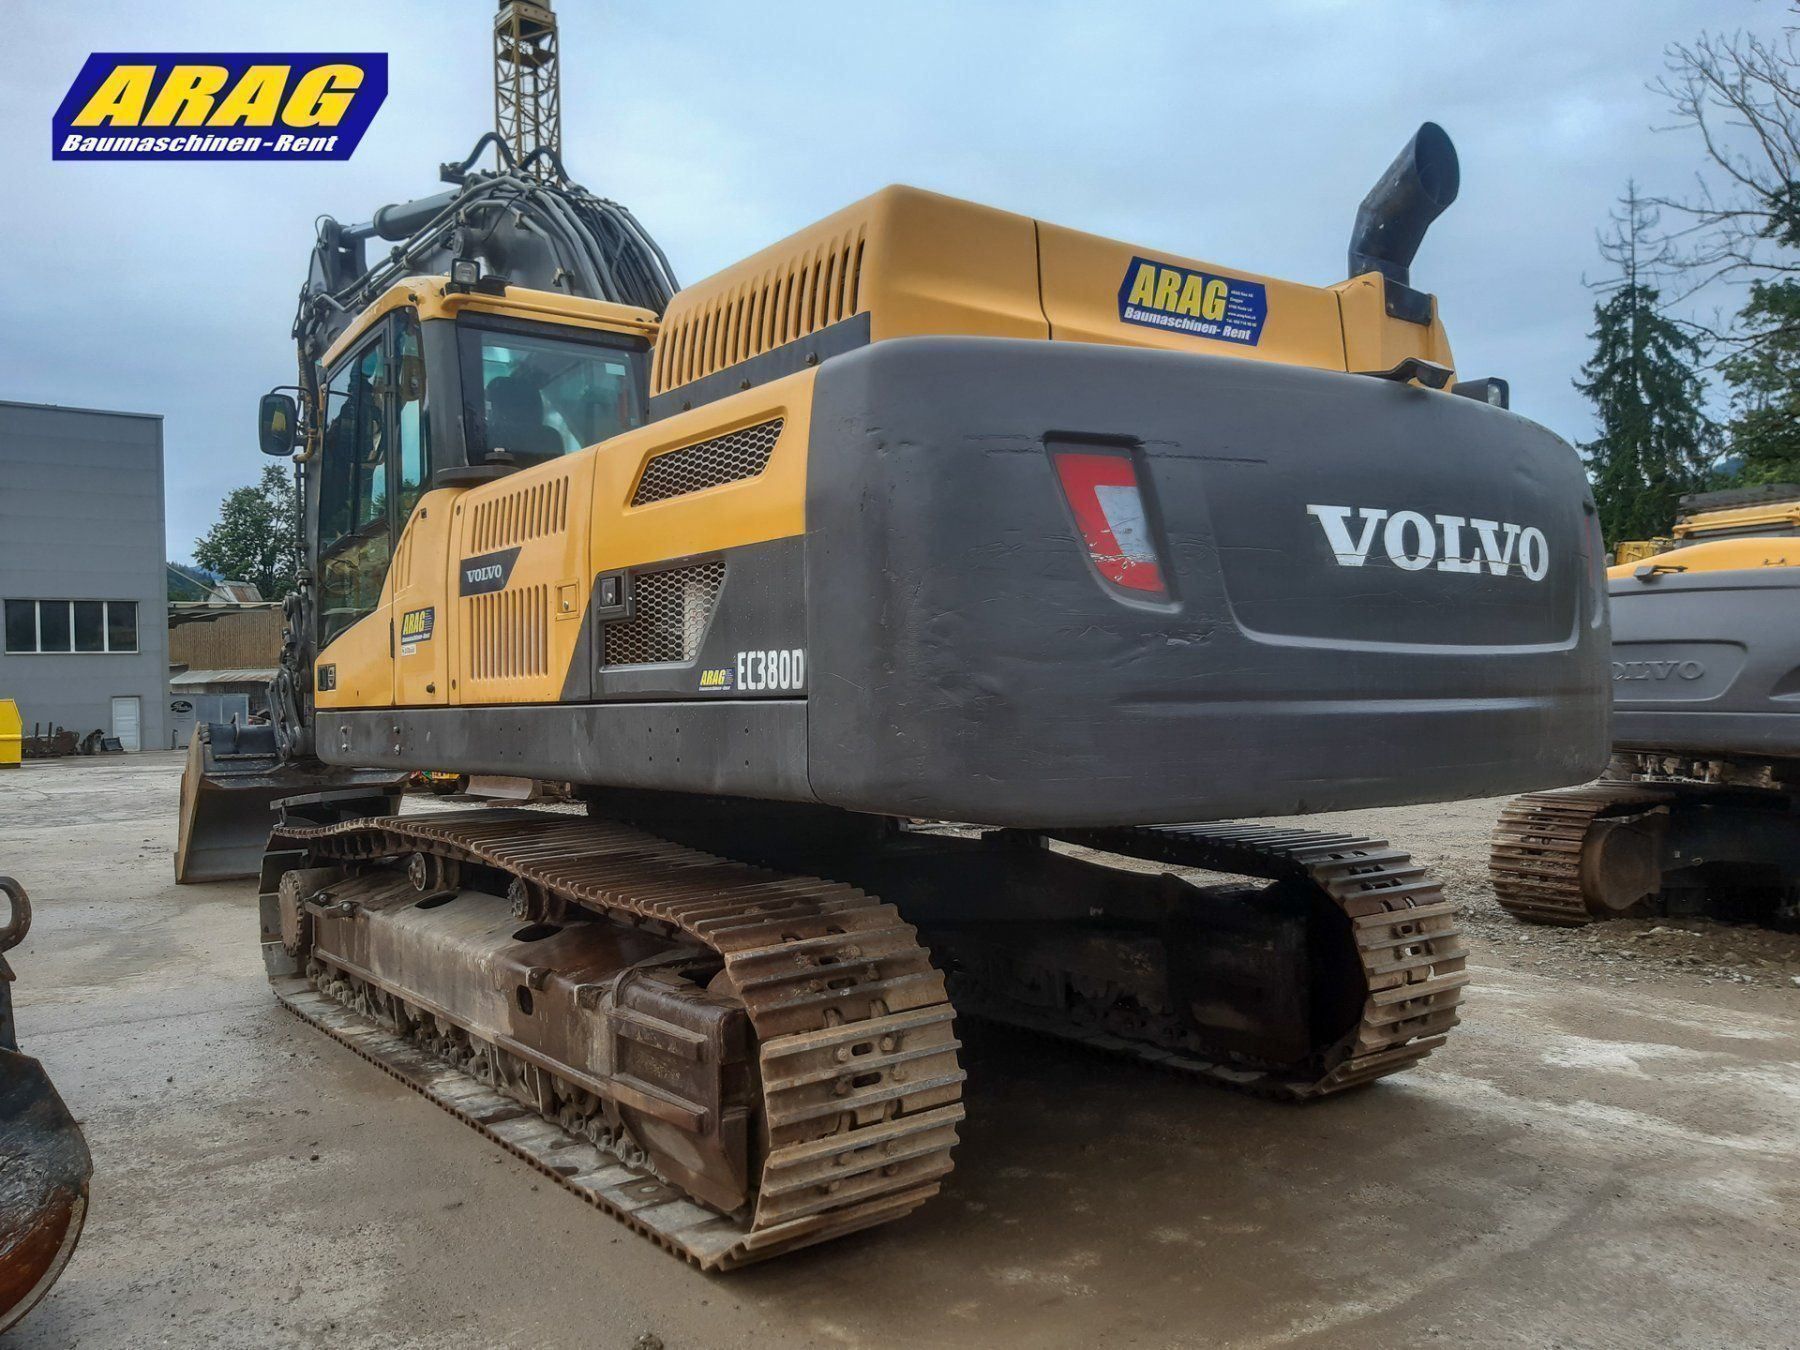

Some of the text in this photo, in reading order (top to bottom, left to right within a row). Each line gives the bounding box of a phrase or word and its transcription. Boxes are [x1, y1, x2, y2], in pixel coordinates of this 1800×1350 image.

[1128, 263, 1228, 322] ARAG
[1306, 504, 1549, 582] VOLVO
[466, 564, 502, 582] VOLVO
[403, 610, 426, 635] ARAG
[700, 669, 726, 686] ARAG
[737, 648, 804, 690] EC380D
